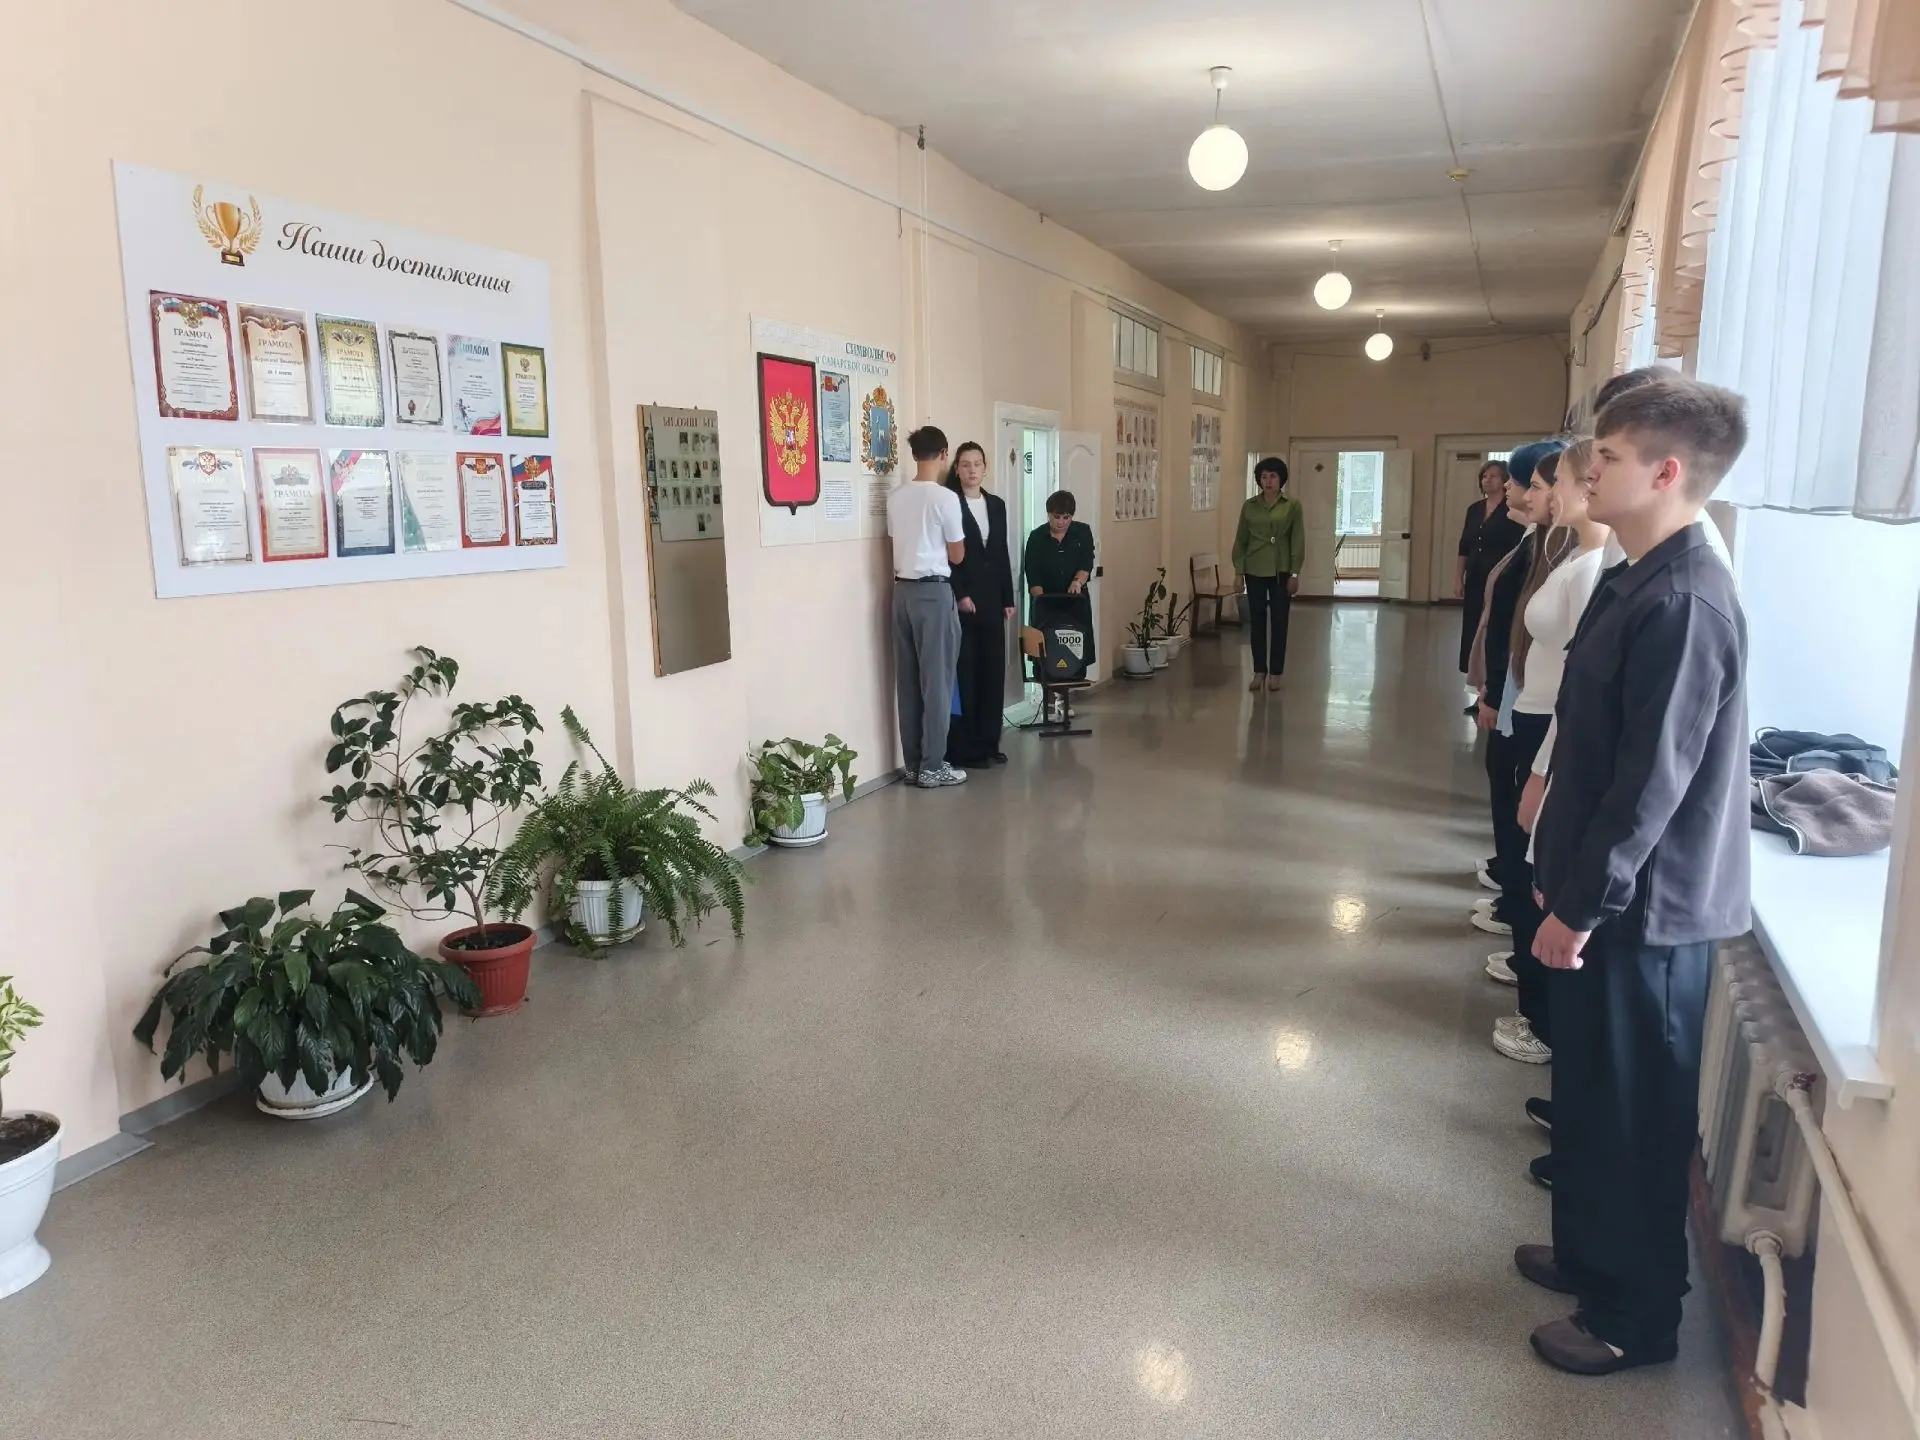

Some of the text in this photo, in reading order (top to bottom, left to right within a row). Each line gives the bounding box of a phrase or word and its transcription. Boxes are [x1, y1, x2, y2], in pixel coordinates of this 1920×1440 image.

[277, 222, 513, 294] Наши достижения
[173, 327, 213, 340] ГРАМОТА
[258, 338, 294, 349] ГРАМОТА
[845, 342, 885, 361] СИМВОЛЫ
[273, 489, 313, 498] ГРАМОТА
[1059, 636, 1081, 644] 1000
